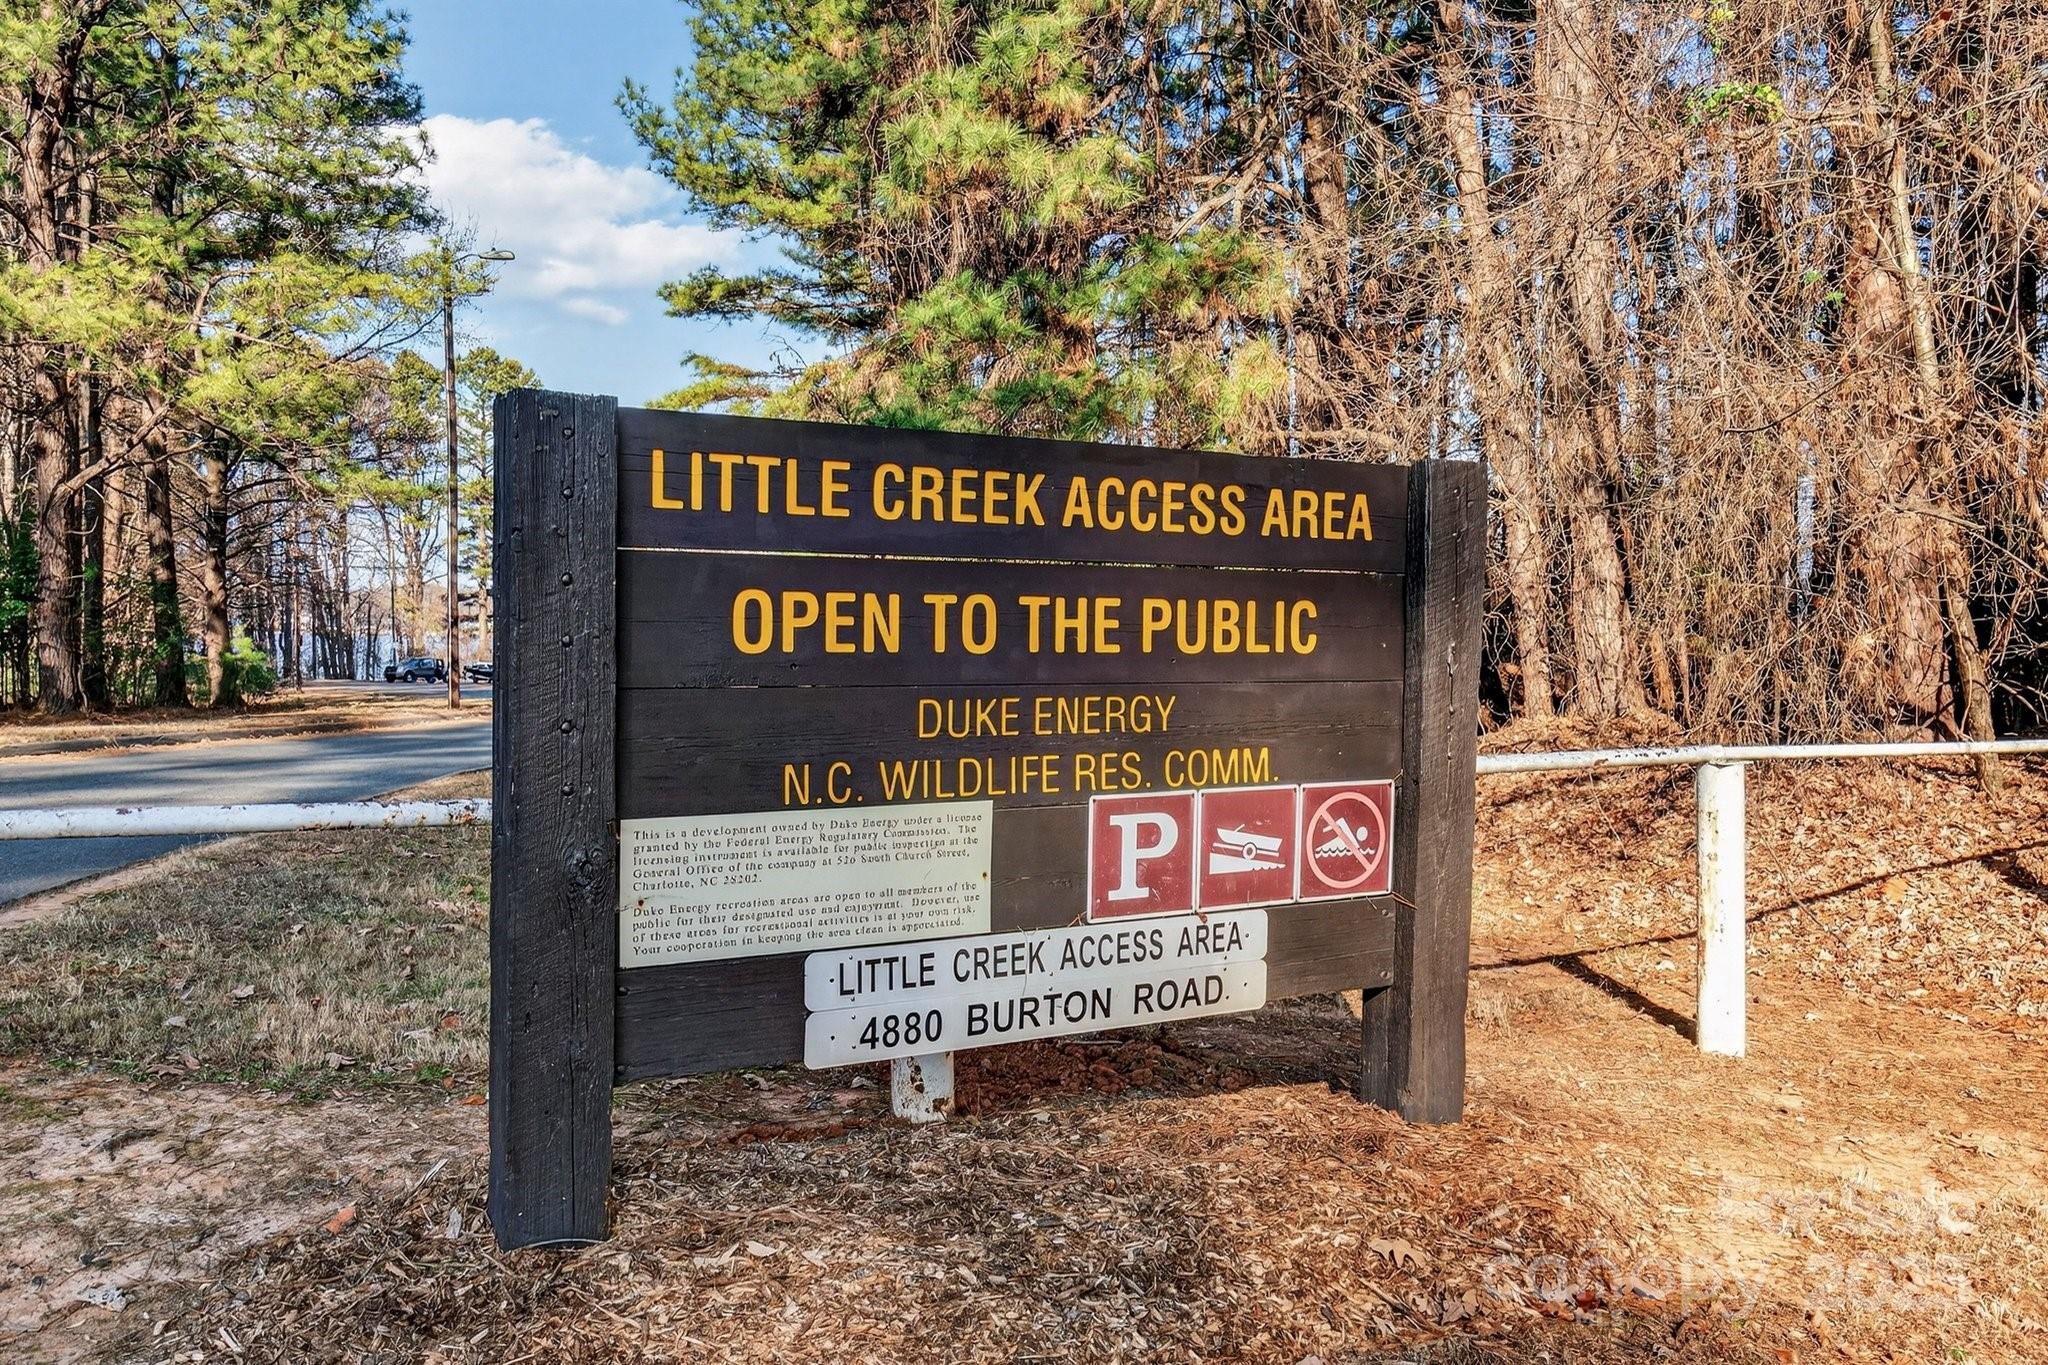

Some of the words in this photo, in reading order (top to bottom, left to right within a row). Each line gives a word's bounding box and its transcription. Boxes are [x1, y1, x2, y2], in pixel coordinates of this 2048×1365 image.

[652, 450, 850, 517] LITTLE
[874, 464, 1044, 525] CREEK
[1062, 477, 1245, 535] ACCESS
[1261, 489, 1372, 541] AREA
[733, 589, 899, 654] OPEN
[924, 594, 996, 654] TO
[1019, 596, 1121, 653] THE
[1142, 598, 1317, 655] PUBLIC
[919, 698, 1018, 738] DUKE
[1035, 695, 1176, 736] ENERGY
[785, 762, 863, 806] N.C.
[880, 755, 1058, 800] WILDLIFE
[1075, 752, 1152, 792] RES.
[1165, 746, 1279, 788] COMM.
[633, 829, 659, 840] This
[665, 828, 675, 839] is
[681, 830, 686, 838] a
[692, 825, 766, 837] development
[771, 821, 807, 832] owned
[811, 821, 825, 832] by
[830, 819, 857, 829] Duke
[862, 817, 899, 829] Energy
[903, 815, 932, 825] under
[946, 813, 982, 822] license
[633, 841, 679, 855] granted
[684, 840, 698, 852] by
[703, 839, 721, 849] the
[726, 836, 769, 847] Federal
[775, 835, 813, 845] Energy
[819, 831, 878, 843] Regulatory
[958, 824, 976, 834] The
[632, 866, 680, 879] General
[685, 864, 723, 876] Office
[728, 861, 740, 873] of
[745, 862, 763, 871] the
[767, 859, 816, 870] company
[822, 858, 831, 866] at
[860, 853, 890, 863] South
[894, 849, 932, 861] Church
[633, 854, 689, 866] licensing
[694, 850, 757, 862] instrument
[762, 848, 772, 857] is
[776, 844, 828, 856] available
[833, 843, 848, 853] for
[853, 841, 887, 854] public
[949, 838, 958, 846] at
[963, 836, 978, 844] the
[1108, 813, 1179, 901] P
[633, 905, 664, 917] Duke
[669, 903, 711, 914] Energy
[716, 897, 775, 910] recreation
[780, 896, 808, 905] areas
[813, 894, 830, 903] are
[834, 892, 860, 902] open
[865, 890, 875, 899] to
[879, 887, 893, 898] all
[946, 881, 957, 892] of
[961, 880, 976, 890] the
[699, 876, 717, 887] NC
[632, 917, 670, 932] public
[676, 916, 693, 926] for
[699, 914, 726, 924] their
[731, 907, 793, 922] designated
[798, 907, 816, 916] use
[821, 903, 839, 914] and
[963, 894, 979, 902] use
[632, 932, 645, 942] of
[650, 931, 681, 941] these
[686, 928, 717, 938] areas
[723, 924, 739, 934] for
[817, 915, 869, 926] activities
[874, 914, 882, 922] is
[887, 912, 896, 921] at
[901, 910, 923, 921] your
[928, 908, 949, 916] own
[632, 945, 661, 956] Your
[666, 938, 736, 952] cooperation
[742, 936, 752, 946] in
[806, 929, 823, 939] the
[828, 929, 850, 937] area
[855, 925, 883, 935] clean
[888, 922, 896, 932] is
[839, 952, 935, 996] LITTLE
[953, 939, 1045, 982] CREEK
[1060, 929, 1163, 971] ACCESS
[1178, 922, 1242, 957] AREA
[860, 1010, 942, 1050] 4880
[967, 988, 1111, 1036] BURTON
